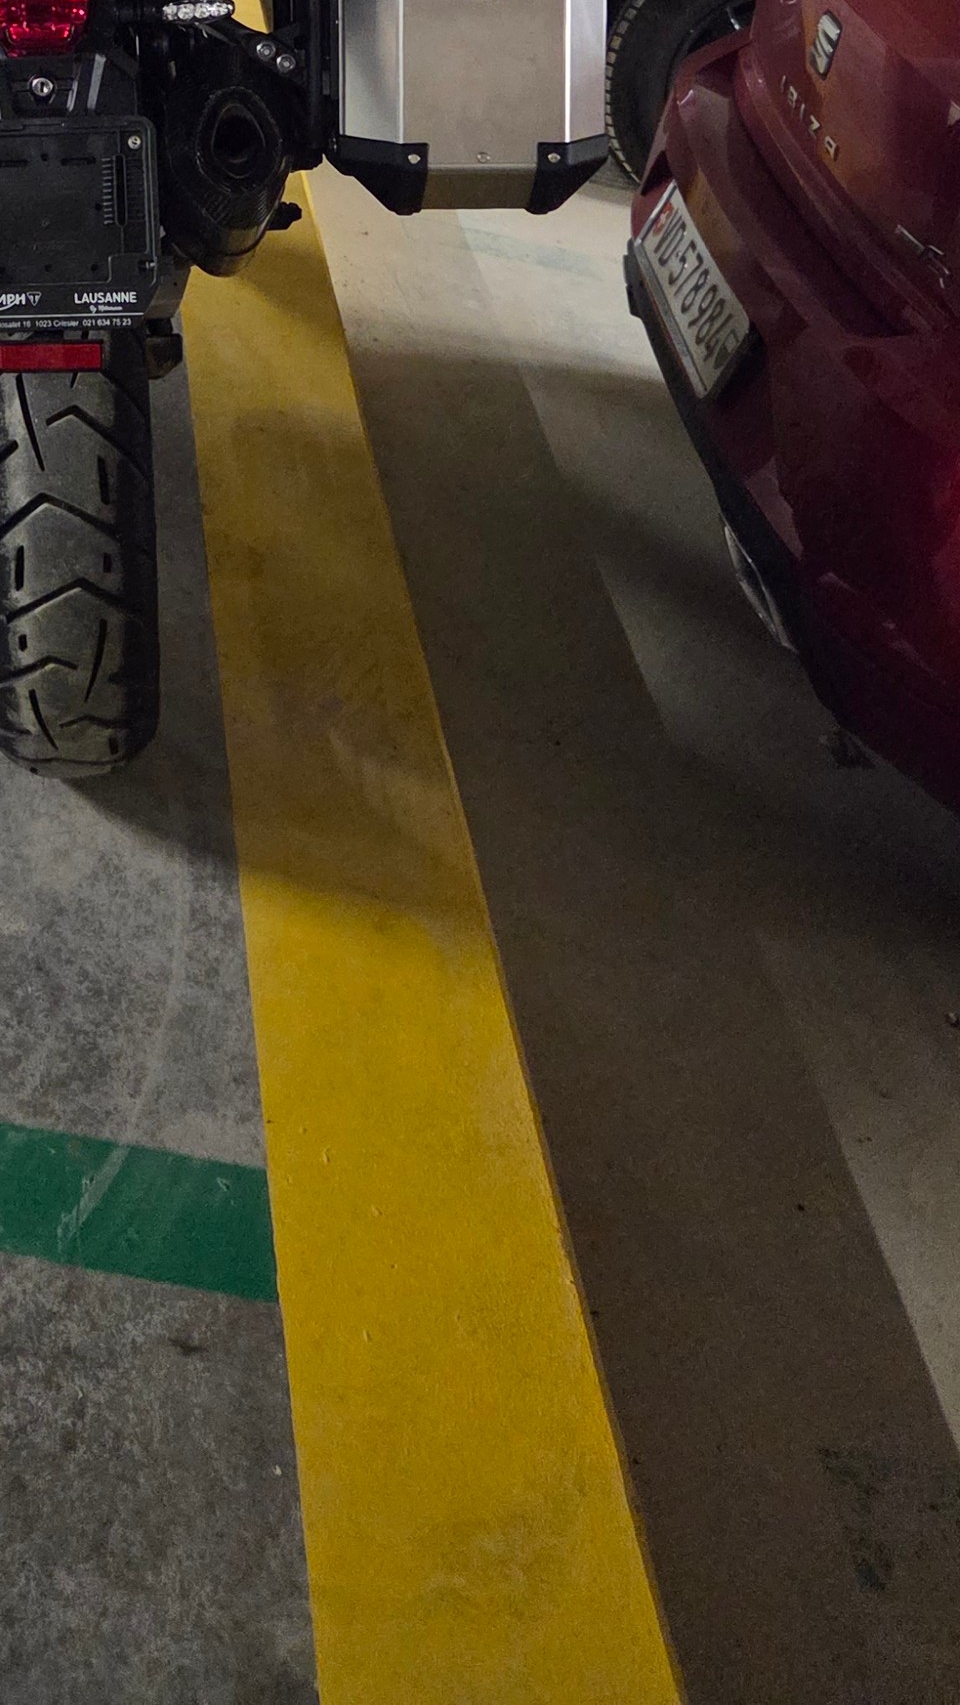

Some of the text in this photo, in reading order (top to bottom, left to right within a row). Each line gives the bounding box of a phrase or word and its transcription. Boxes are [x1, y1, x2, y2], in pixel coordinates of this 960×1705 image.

[780, 75, 838, 161] IBIZA
[74, 292, 137, 304] LAUSANNE
[35, 320, 52, 328] 1023
[82, 319, 95, 327] 021
[122, 318, 132, 326] 23
